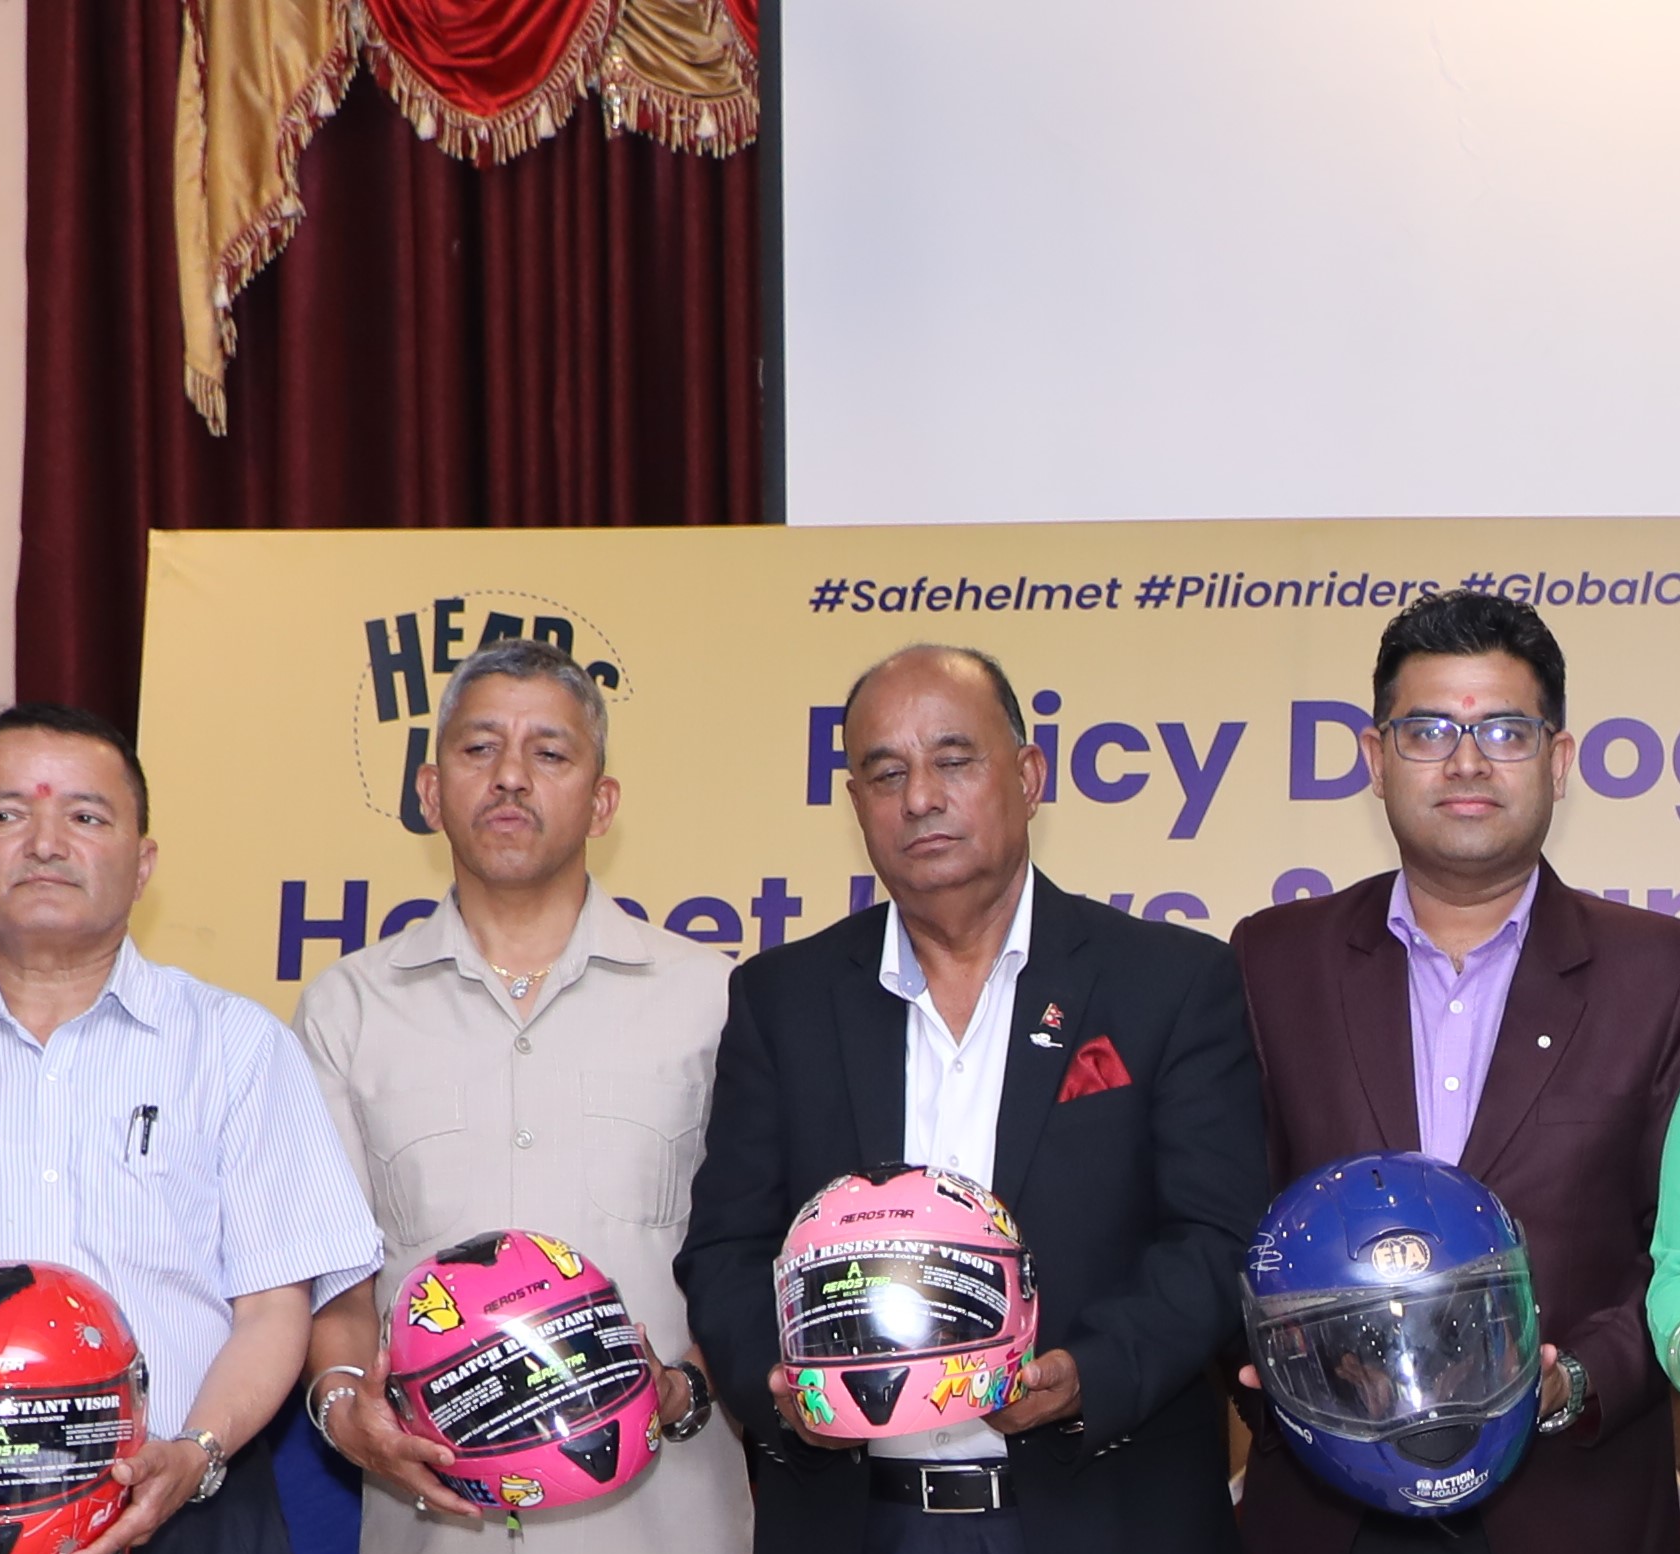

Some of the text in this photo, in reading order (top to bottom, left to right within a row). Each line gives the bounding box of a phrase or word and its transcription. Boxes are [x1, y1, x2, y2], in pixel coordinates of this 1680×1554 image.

[809, 576, 1122, 613] #Safehelmet
[1134, 572, 1441, 609] #Pilionriders
[839, 1210, 915, 1225] AEROSTAR
[819, 1239, 935, 1257] RESISTANT
[938, 1246, 995, 1276] VISOR
[822, 1276, 892, 1295] AEROSTAR
[429, 1346, 503, 1395] SCRATCH
[74, 1395, 120, 1411] VISOR
[1431, 1487, 1458, 1499] ROAD
[1459, 1469, 1489, 1493] SAFETY
[1434, 1468, 1476, 1491] ACTION
